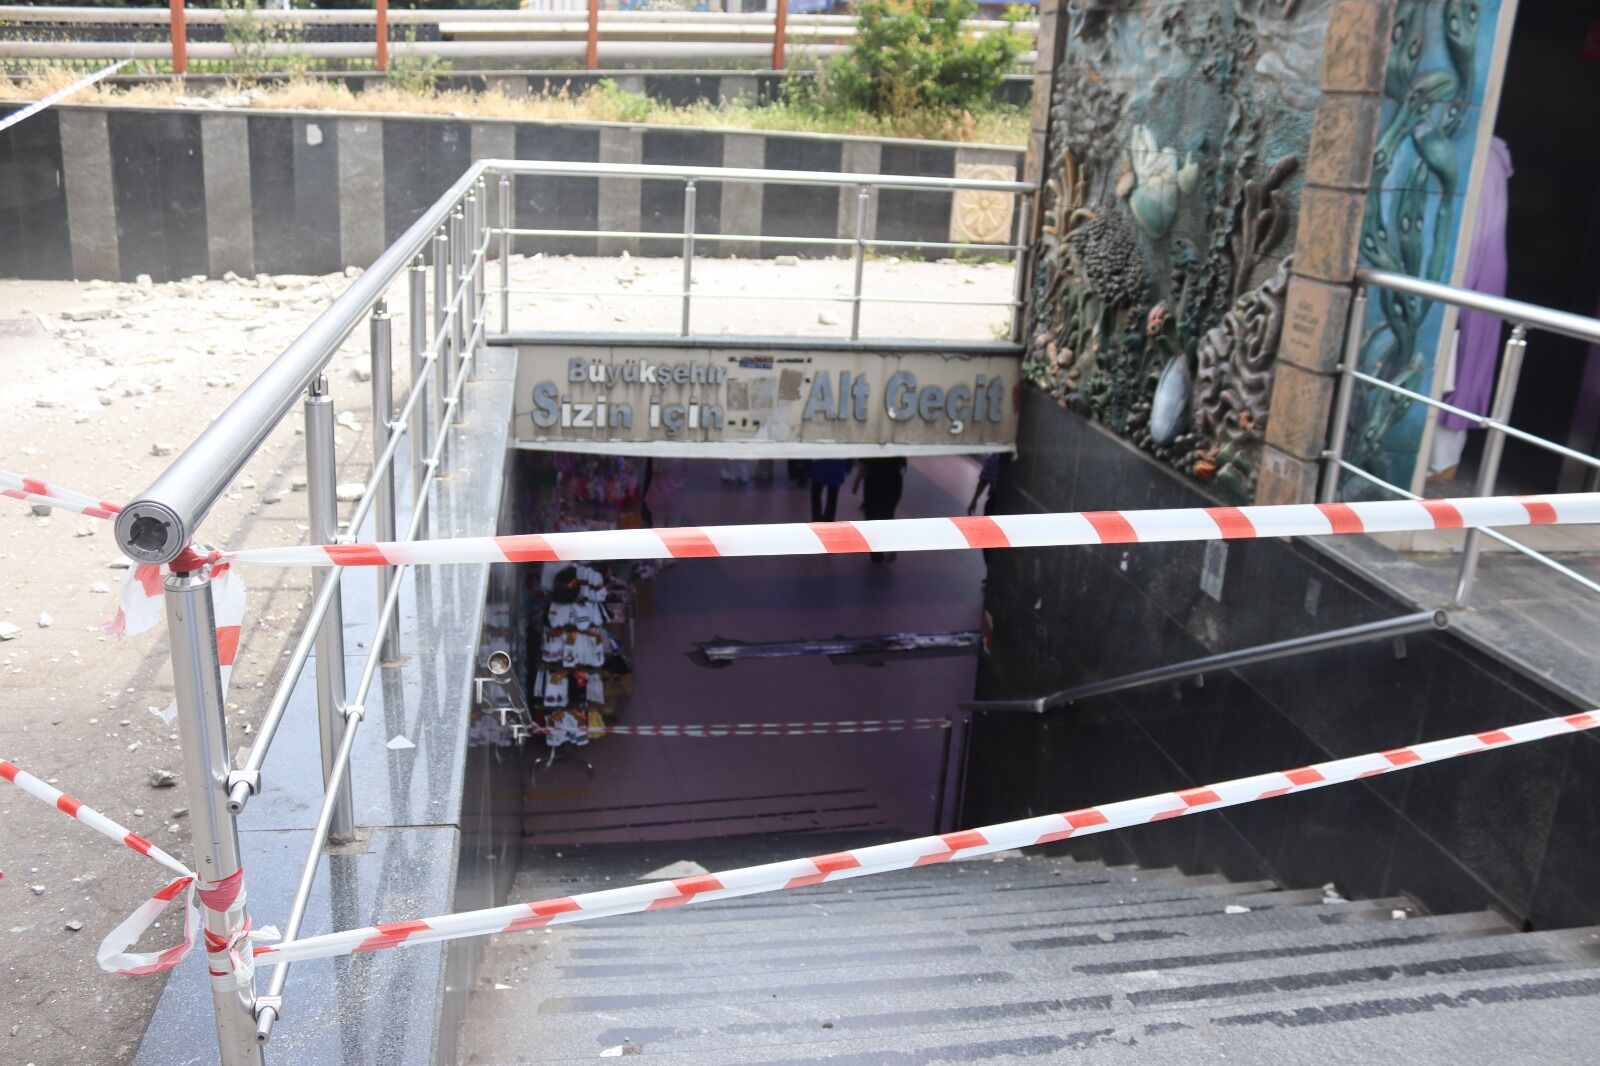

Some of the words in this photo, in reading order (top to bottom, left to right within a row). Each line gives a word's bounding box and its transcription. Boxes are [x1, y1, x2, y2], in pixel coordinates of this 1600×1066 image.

[532, 379, 633, 429] Sizin
[802, 371, 870, 422] Alt
[885, 370, 1005, 435] Geçit
